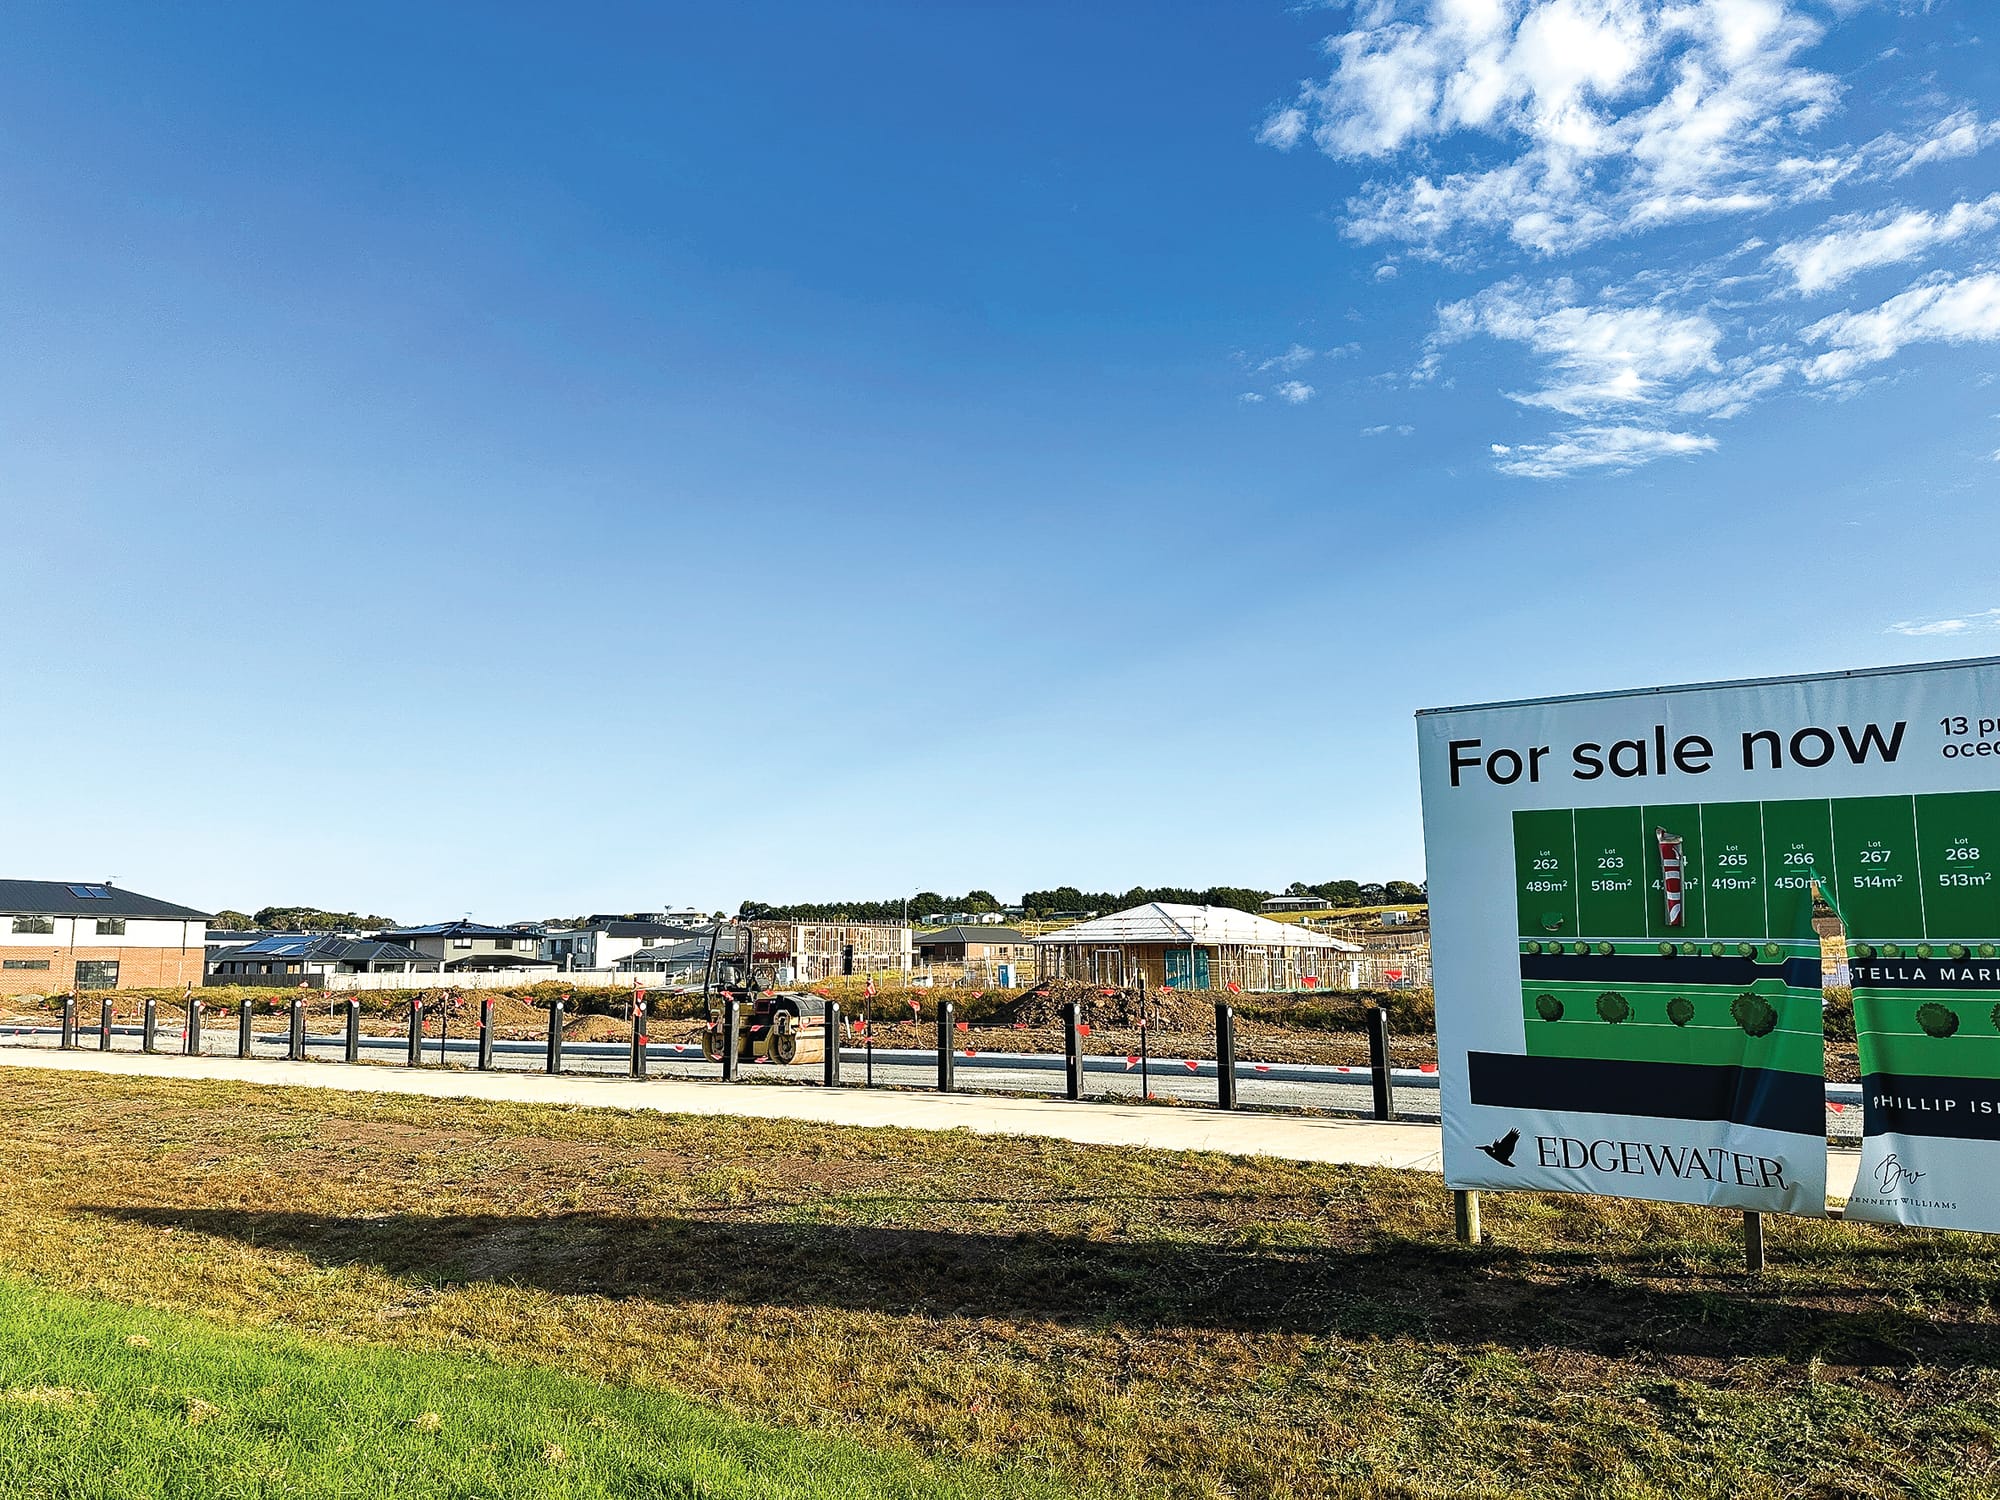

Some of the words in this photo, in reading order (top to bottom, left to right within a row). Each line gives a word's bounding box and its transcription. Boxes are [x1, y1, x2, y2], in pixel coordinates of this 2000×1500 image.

[1940, 717, 1969, 735] 13
[1448, 739, 1550, 787] For
[1572, 725, 1714, 781] sale
[1741, 721, 1907, 770] now
[1718, 854, 1748, 866] 265
[1783, 853, 1815, 865] 266
[1860, 850, 1891, 863] 267
[1945, 848, 1980, 860] 268
[1533, 859, 1558, 870] 262
[1598, 857, 1624, 868] 263
[1526, 879, 1568, 892] 489m²
[1591, 879, 1633, 891] 518m²
[1651, 877, 1699, 890] 4m²
[1711, 877, 1756, 889] 419m²
[1853, 874, 1903, 888] 514m²
[1939, 872, 1992, 886] 513m²
[1849, 967, 1926, 980] STELLA
[1873, 1094, 1956, 1112] PHILLIP
[1534, 1135, 1790, 1191] EDGEWATER
